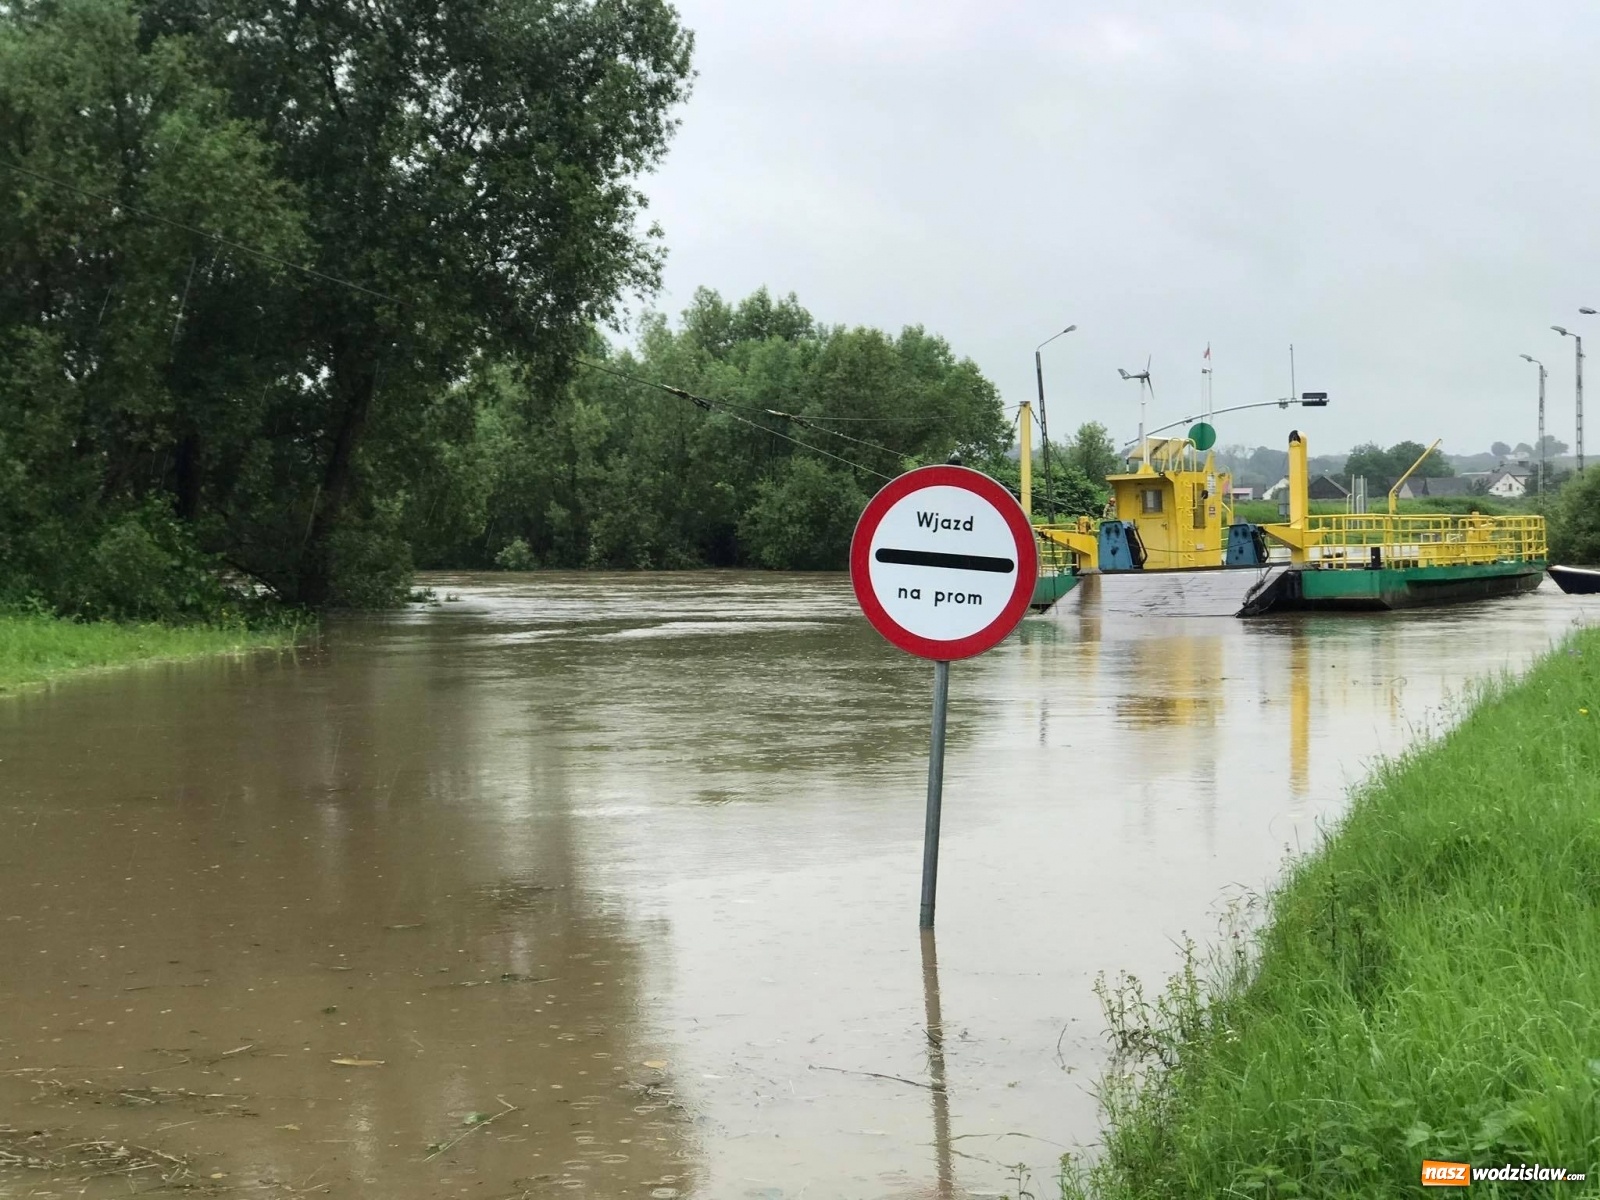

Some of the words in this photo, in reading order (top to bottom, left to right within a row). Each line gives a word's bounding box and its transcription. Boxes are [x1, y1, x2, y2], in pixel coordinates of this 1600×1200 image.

[917, 511, 974, 533] Wjazd
[898, 587, 921, 600] na
[934, 591, 983, 607] prom
